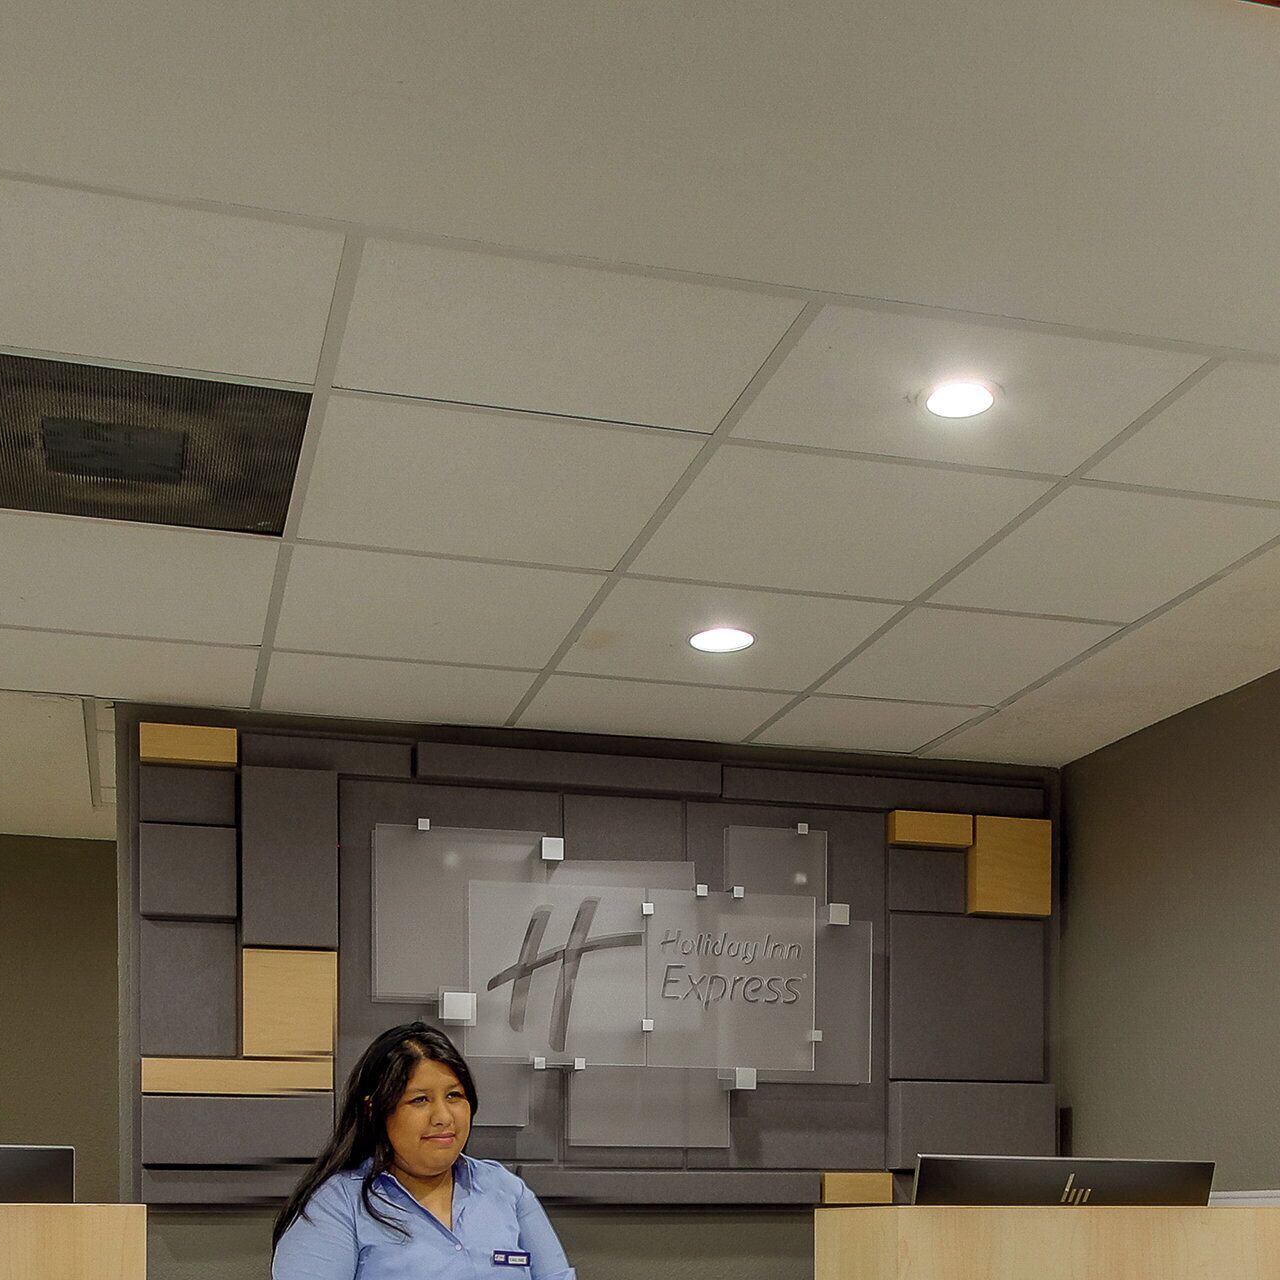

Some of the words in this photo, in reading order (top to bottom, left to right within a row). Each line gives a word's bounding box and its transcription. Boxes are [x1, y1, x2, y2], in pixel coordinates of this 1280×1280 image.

[660, 928, 758, 965] Holiday
[762, 932, 803, 960] Inn
[660, 963, 803, 1012] Express
